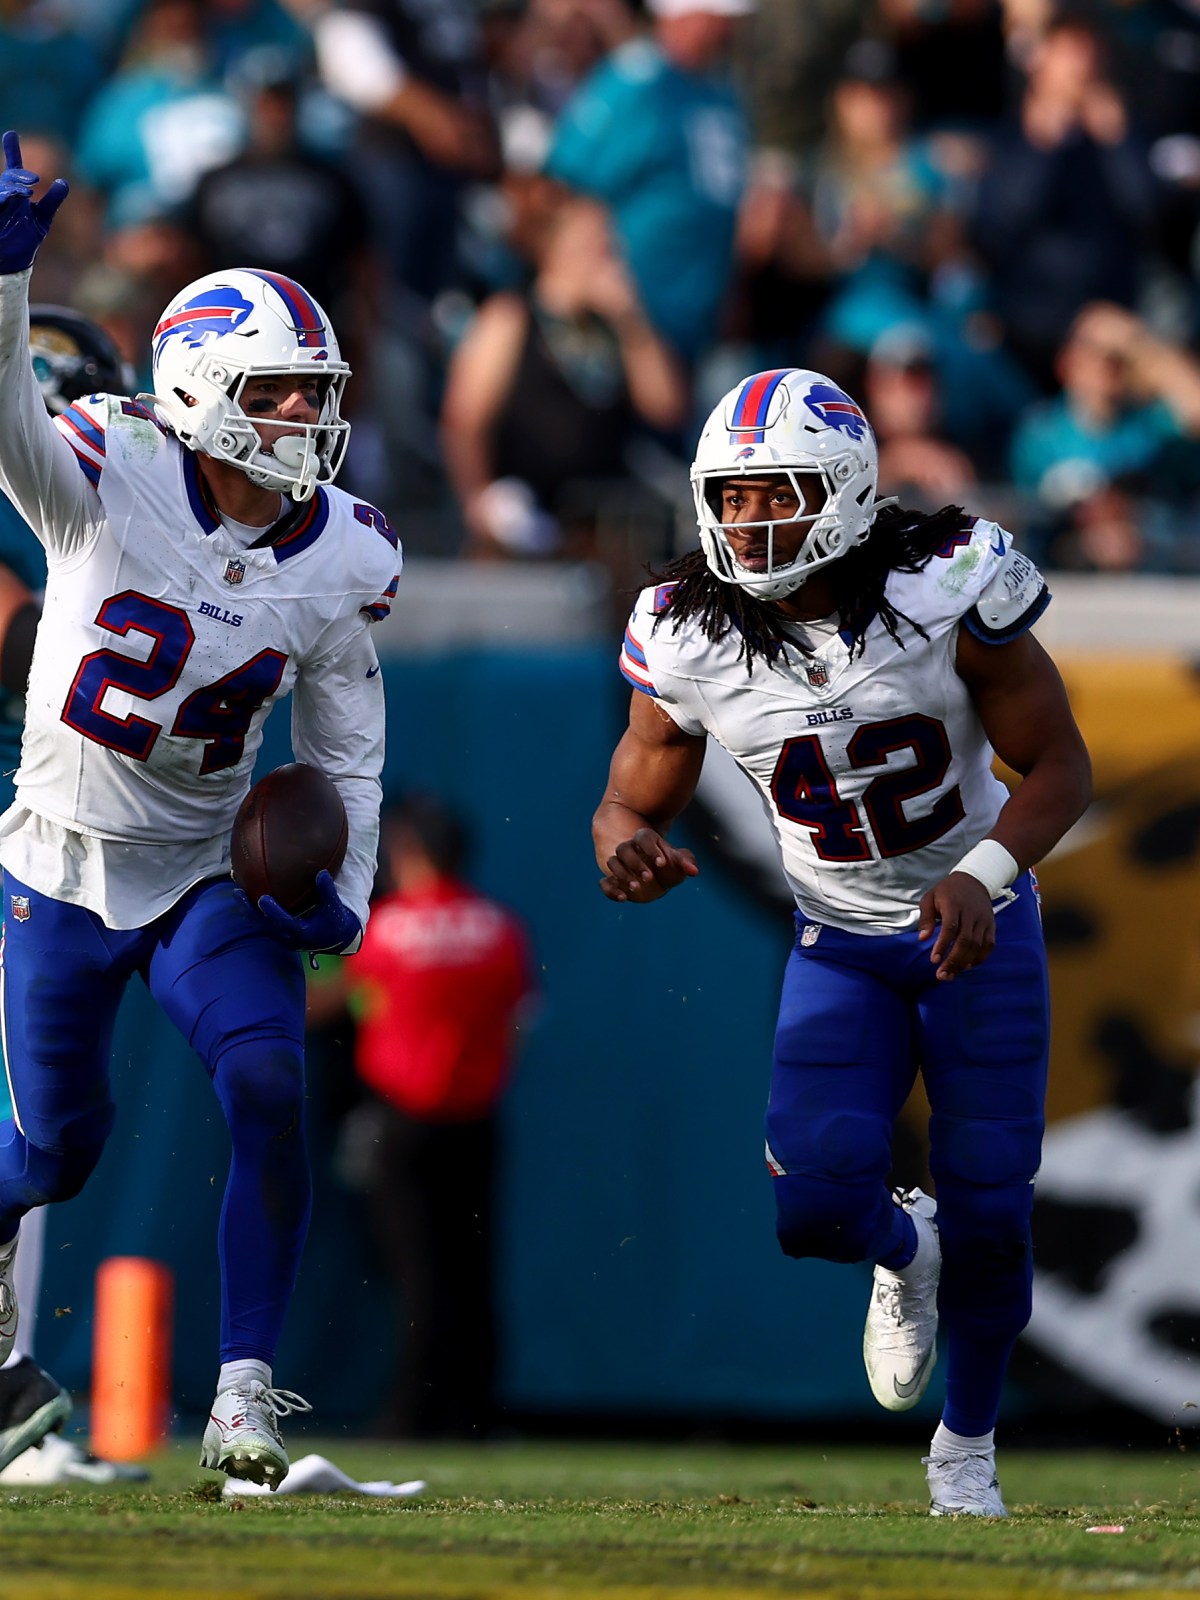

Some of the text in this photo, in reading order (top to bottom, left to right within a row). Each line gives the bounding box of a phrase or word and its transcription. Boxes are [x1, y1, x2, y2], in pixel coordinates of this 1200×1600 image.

[353, 503, 400, 551] 2
[197, 600, 243, 627] BILLS
[60, 589, 289, 777] 24
[805, 707, 854, 726] BILLS
[770, 712, 967, 863] 42
